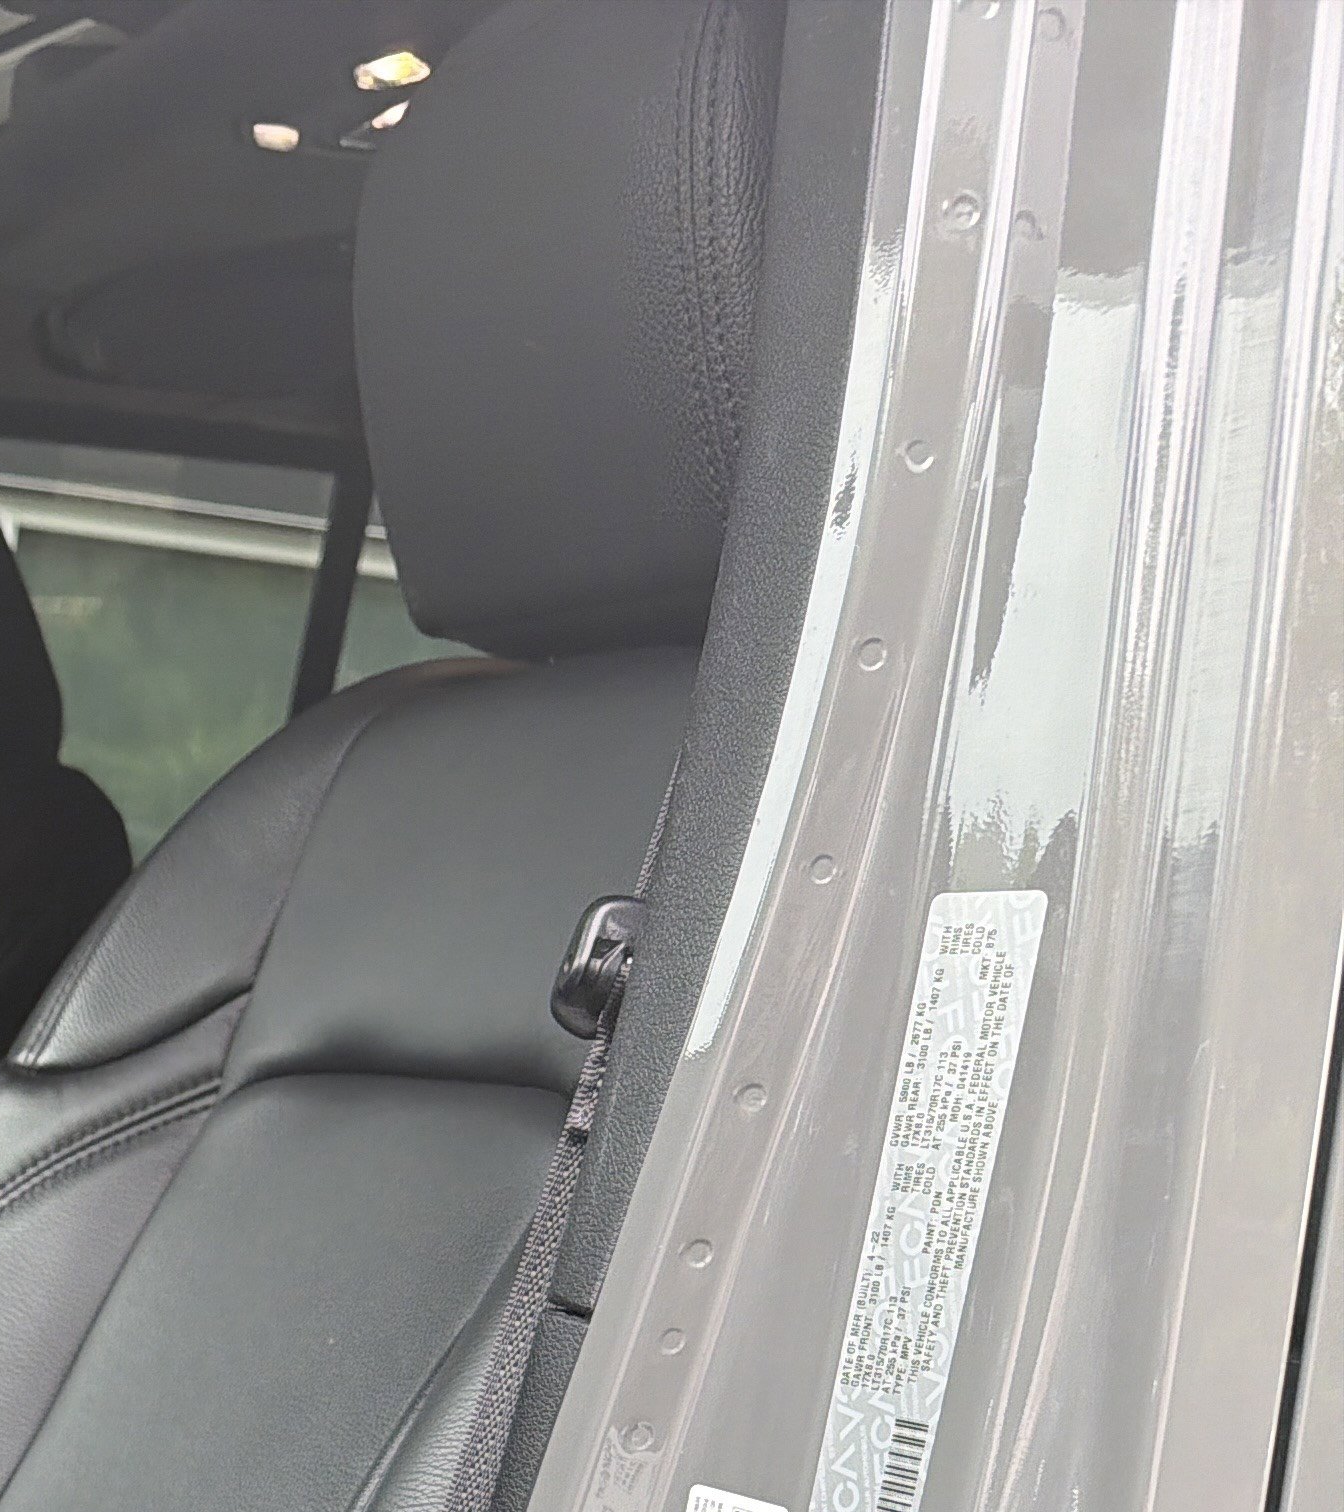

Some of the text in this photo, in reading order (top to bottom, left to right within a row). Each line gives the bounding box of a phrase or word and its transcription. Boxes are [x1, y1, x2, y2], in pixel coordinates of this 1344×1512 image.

[939, 925, 954, 954] WITH
[949, 926, 963, 954] RIMS
[971, 926, 986, 954] COLD
[933, 968, 945, 982] KG
[987, 951, 1006, 996] VEHICLE
[927, 986, 941, 1010] 1407
[936, 1051, 948, 1070] 113
[960, 922, 975, 954] TIRES
[915, 1002, 927, 1016] KG
[978, 1001, 995, 1040] MOTOR
[921, 1027, 933, 1040] LB
[915, 1044, 929, 1069] 3100
[949, 1040, 962, 1057] PSI
[903, 1061, 915, 1073] LB
[946, 1062, 957, 1074] 37
[967, 1043, 986, 1094] FEDERAL
[897, 1077, 911, 1102] 5900
[899, 1114, 915, 1147] GAWR
[930, 1135, 942, 1150] AT
[890, 1162, 905, 1191] WITH
[901, 1165, 914, 1192] RIMS
[921, 963, 1015, 1372] SAFETY AND THEFT PREVENTION STANDARDS IN EFFECT ON THE DATE OF
[921, 1166, 936, 1194] COLD
[945, 1136, 967, 1202] APPLICABLE
[884, 1205, 896, 1220] KG
[940, 1206, 953, 1226] ALL
[953, 1186, 980, 1269] MANUFACTURE
[971, 1141, 990, 1182] SHOWN
[879, 1223, 892, 1247] 1407
[886, 1295, 898, 1314] 113
[911, 1162, 925, 1193] TIRES
[936, 1229, 948, 1243] TO
[873, 1263, 884, 1276] LB
[923, 1247, 944, 1308] CONFORMS
[867, 1280, 880, 1304] 3100
[899, 1285, 911, 1303] PSI
[850, 1313, 863, 1336] MFR
[896, 1306, 907, 1319] 37
[913, 1310, 931, 1355] VEHICLE
[846, 1340, 858, 1354] OF
[899, 1335, 912, 1360] MPV
[840, 1357, 854, 1385] DATE
[850, 1354, 865, 1387] GAWR
[907, 1358, 921, 1384] THIS
[880, 1378, 892, 1393] AT
